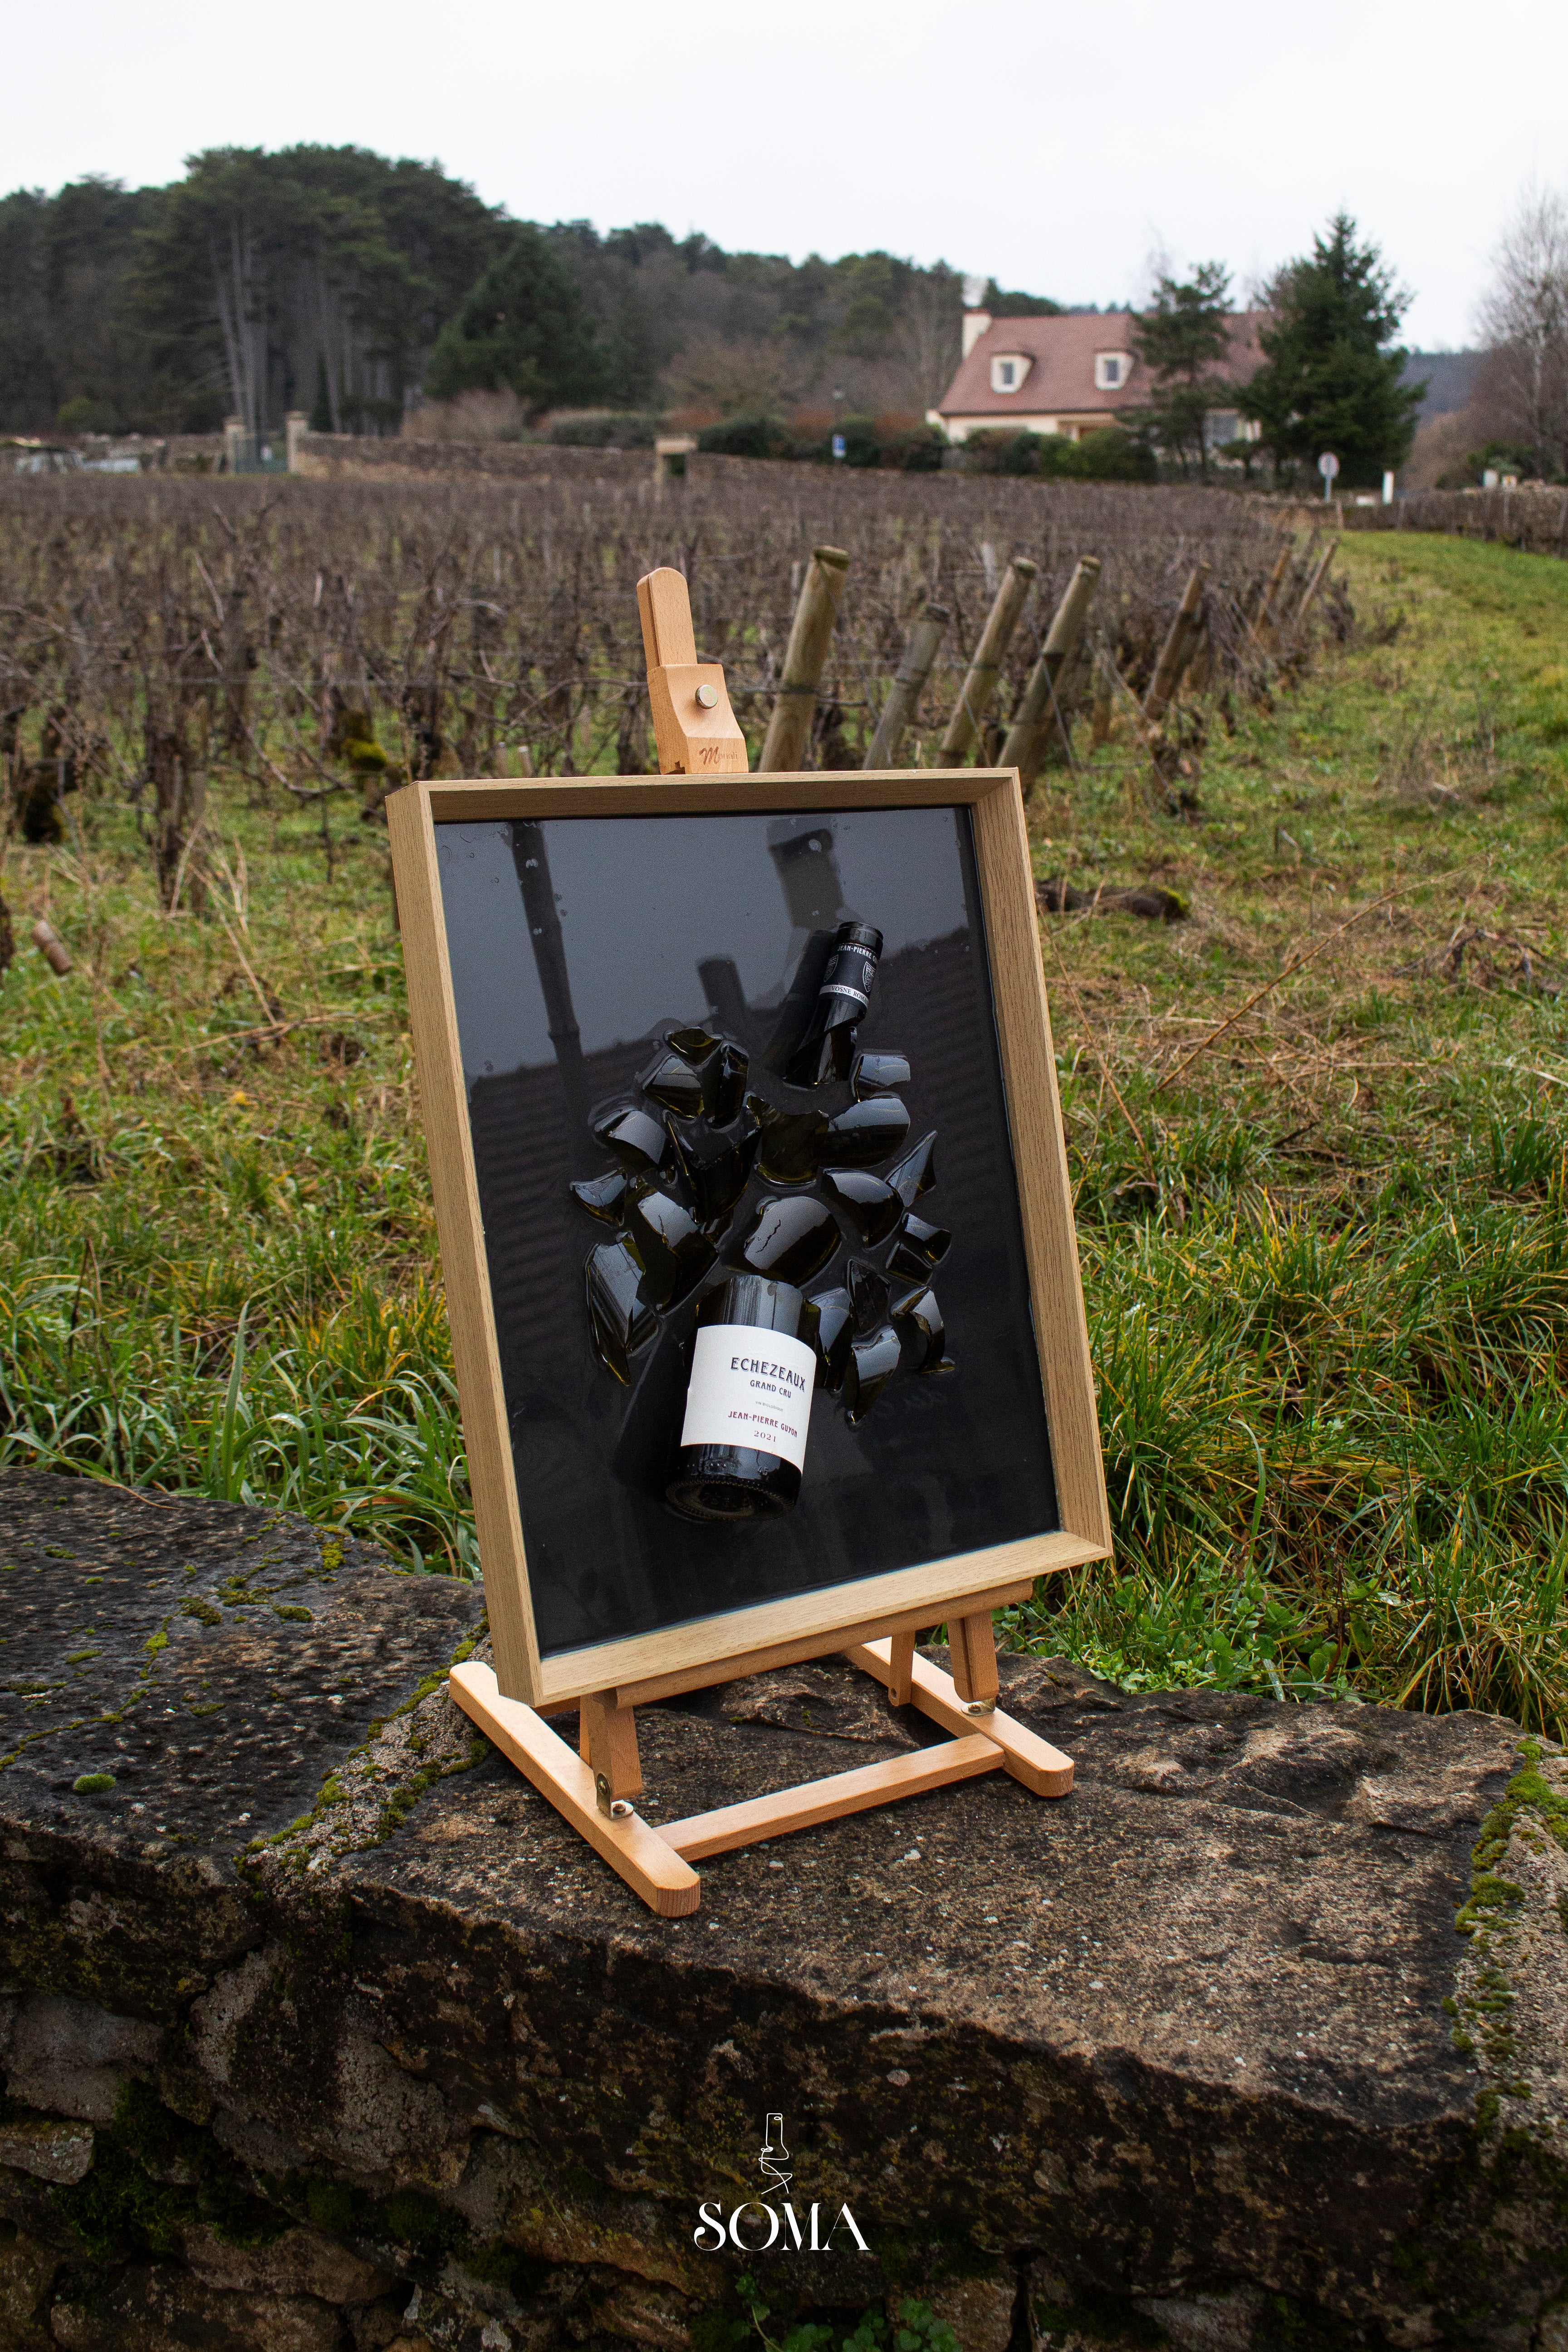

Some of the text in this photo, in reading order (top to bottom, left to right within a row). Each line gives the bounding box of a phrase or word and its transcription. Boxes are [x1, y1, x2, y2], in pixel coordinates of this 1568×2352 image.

[838, 945, 872, 959] JEAN-PIERRE
[832, 986, 851, 995] VOSNE
[730, 1357, 806, 1392] ECHEZEAUX
[750, 1380, 791, 1398] GRAND CRU
[728, 1411, 798, 1437] JEAN-PIERRE GUYON
[754, 1431, 776, 1442] 2021
